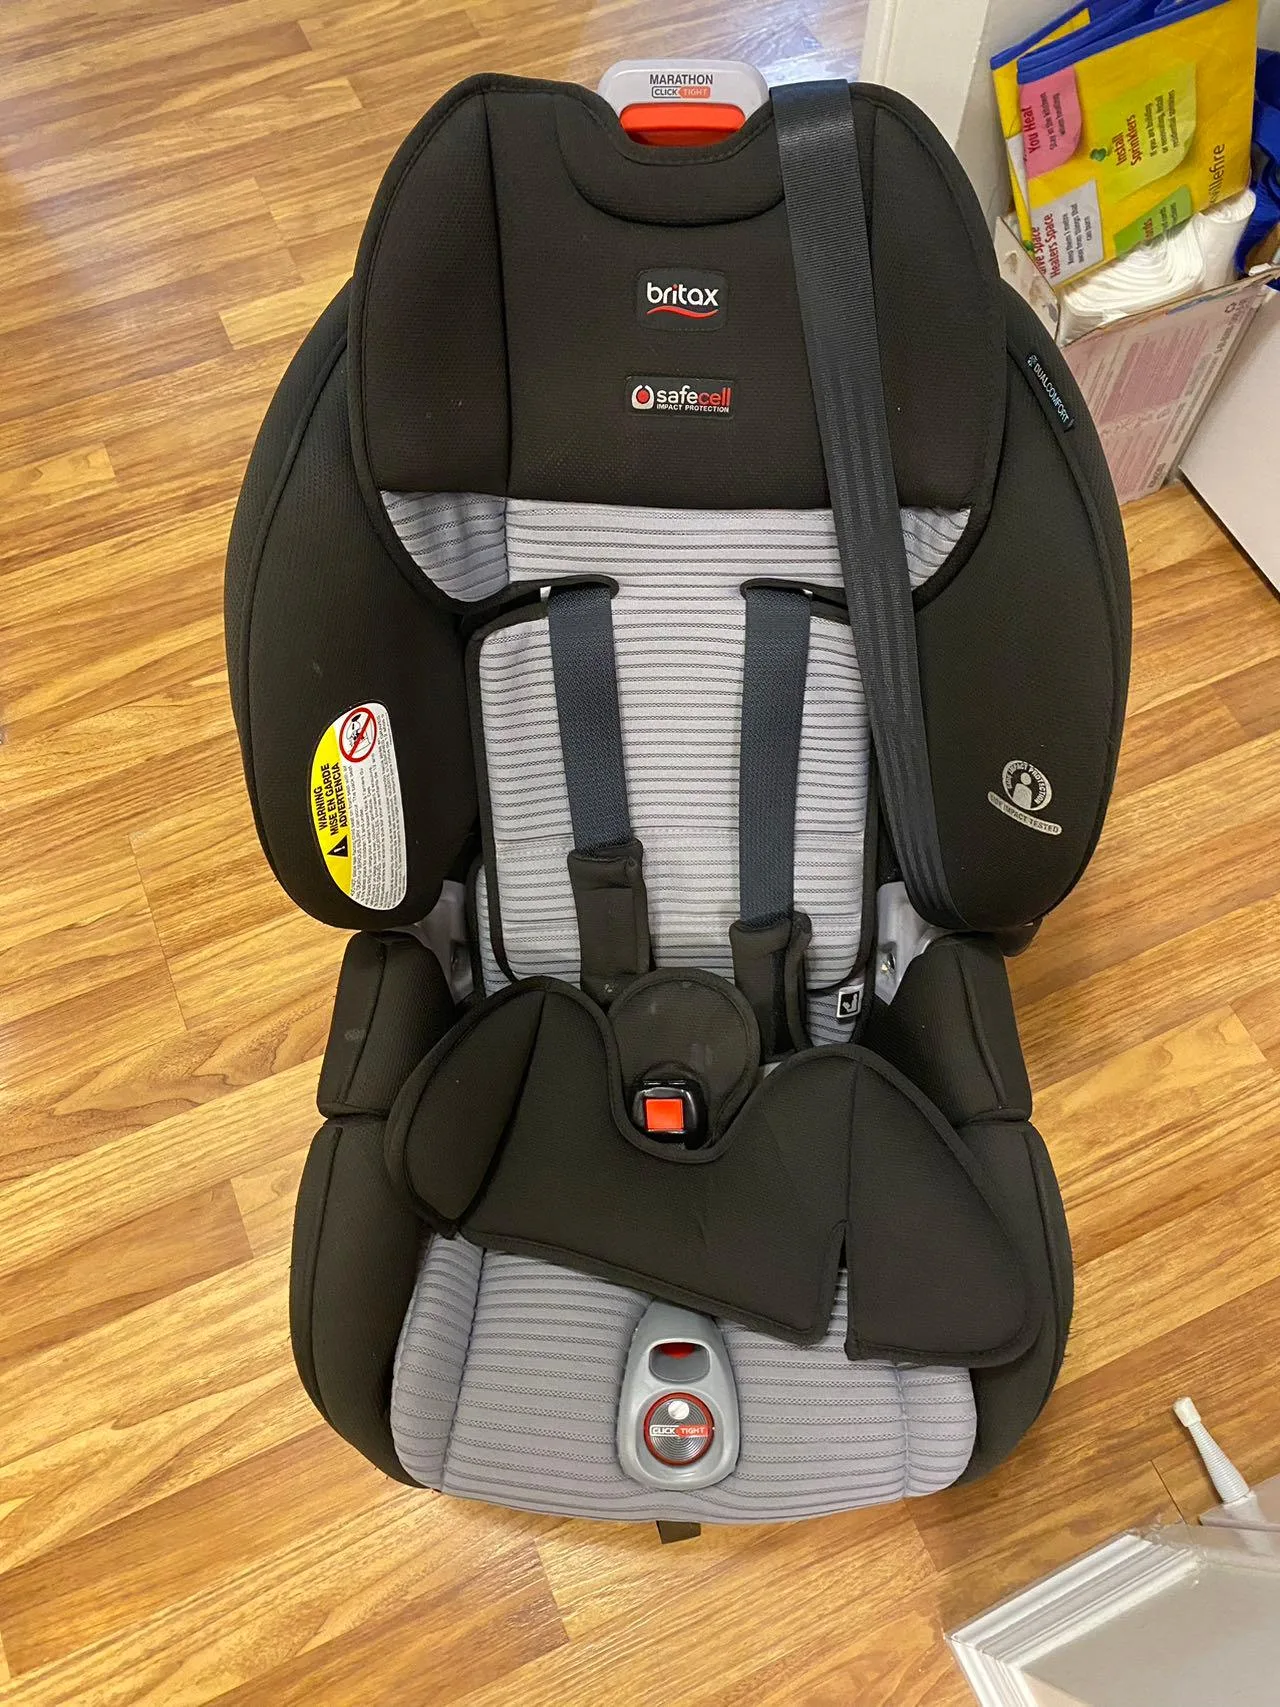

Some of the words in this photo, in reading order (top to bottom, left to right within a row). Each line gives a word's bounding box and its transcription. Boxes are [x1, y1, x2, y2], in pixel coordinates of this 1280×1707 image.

[650, 74, 713, 85] MARATHON
[654, 88, 678, 96] CLICK
[683, 88, 708, 96] TIGHT
[1027, 131, 1041, 154] You
[1111, 132, 1127, 166] Install
[1126, 114, 1143, 166] Sprinklers
[1031, 226, 1044, 254] Space
[1043, 213, 1057, 243] Space
[1048, 241, 1061, 278] Heaters
[647, 282, 719, 306] britax
[656, 385, 732, 407] safecell
[1033, 363, 1070, 423] DUALCOMFORT
[685, 404, 729, 413] PROTECTION
[321, 762, 334, 798] GARDE
[1028, 766, 1047, 805] PROTECTION
[314, 786, 327, 831] WARNING
[326, 799, 337, 813] EN
[331, 762, 348, 828] ADVERTENCIA
[329, 813, 339, 837] MISE
[1029, 818, 1059, 833] TESTED
